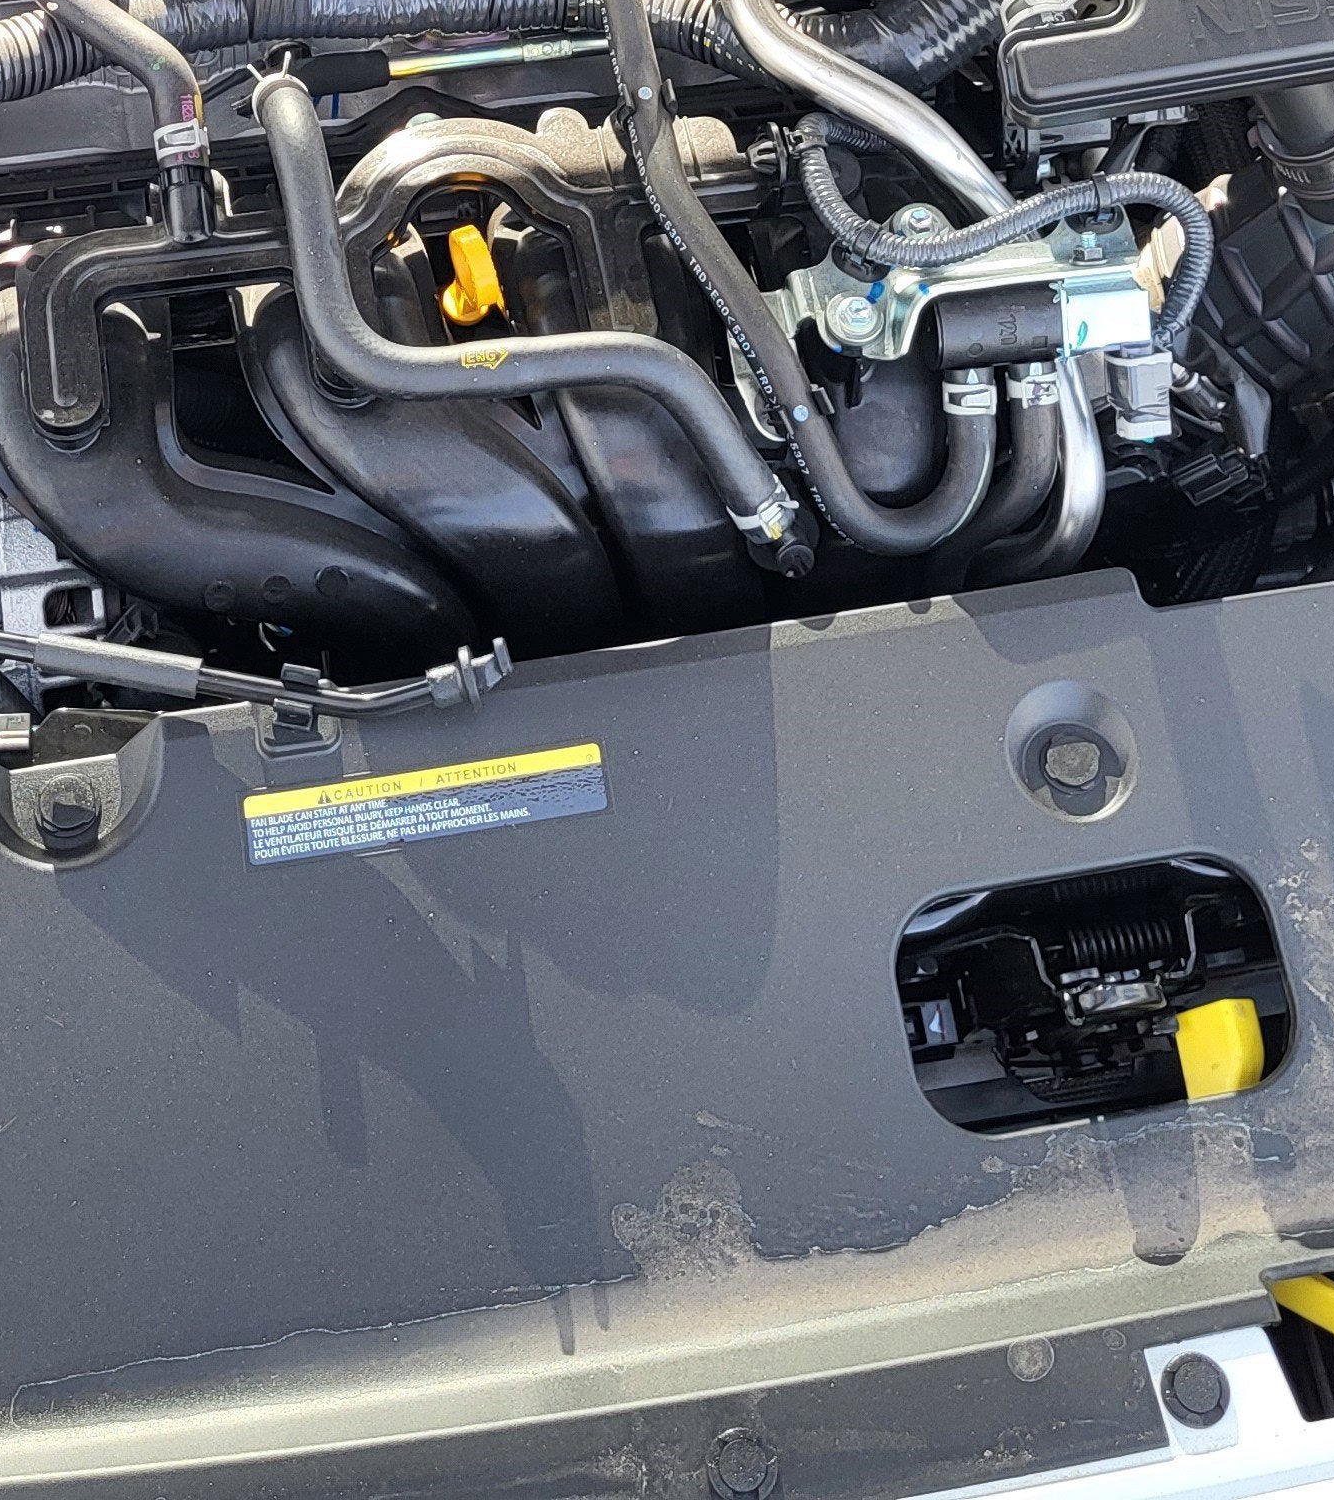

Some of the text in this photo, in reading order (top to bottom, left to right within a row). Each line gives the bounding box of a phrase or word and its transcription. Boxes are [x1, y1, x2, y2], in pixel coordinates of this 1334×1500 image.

[466, 349, 496, 363] ENG
[333, 779, 402, 801] CAUTION
[434, 761, 518, 785] ATTENTION
[250, 817, 267, 828] FAN
[267, 813, 294, 826] BLADE
[294, 810, 313, 821] CAN
[312, 805, 338, 818] START
[338, 804, 349, 814] AT
[252, 828, 265, 838] TO
[264, 824, 286, 836] HELP
[285, 820, 311, 833] AVOID
[312, 813, 354, 829] PERSONAL
[383, 805, 404, 817] KEEP
[403, 801, 433, 814] HANDS
[432, 796, 461, 810] CLEAR.
[252, 839, 264, 849] LE
[264, 829, 323, 847] VENTILATEUR
[322, 823, 359, 838] RISQUE
[359, 821, 369, 832] DE
[368, 812, 417, 830] DÉMARRER
[425, 809, 449, 821] TOUT
[449, 802, 492, 817] MOMENT.
[253, 806, 530, 860] POUR ÉVITER TOUTE BLESSURE, NE PAS EN APPROCHER LES MAINS.
